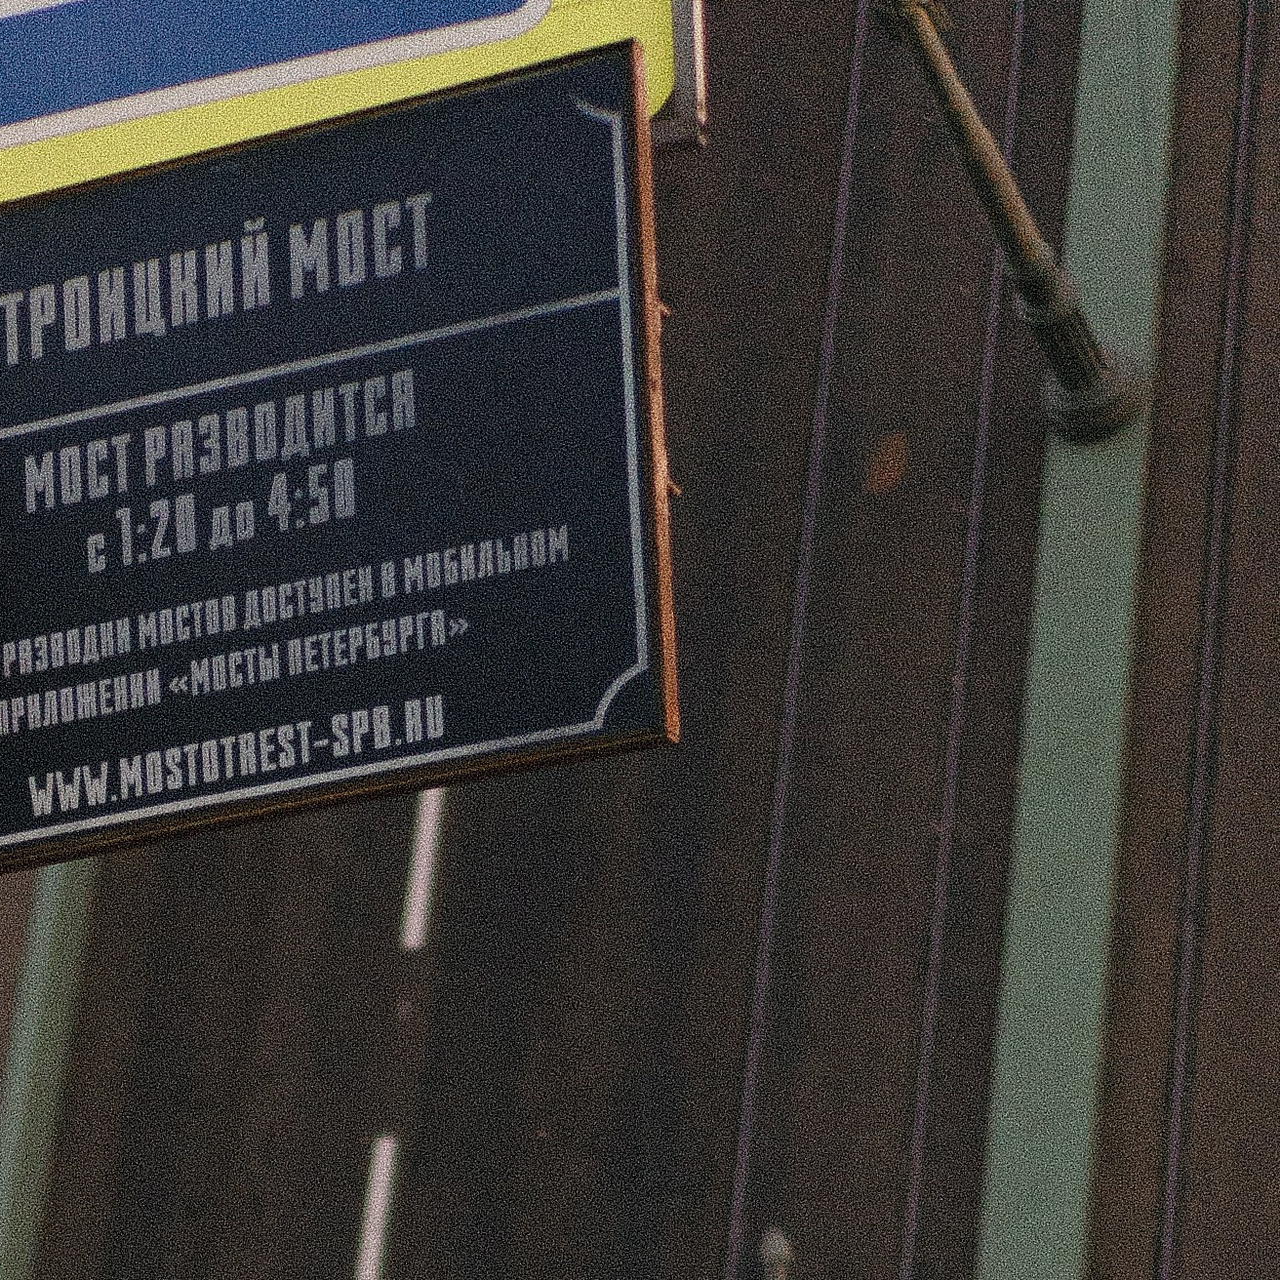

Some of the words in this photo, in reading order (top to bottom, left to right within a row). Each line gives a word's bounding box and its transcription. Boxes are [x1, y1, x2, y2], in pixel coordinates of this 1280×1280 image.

[288, 191, 434, 300] МОСТ
[24, 433, 132, 513] МОСТ
[144, 369, 417, 487] РАЗВОДИТСЯ
[86, 533, 106, 574] с
[116, 494, 197, 567] 1:20
[209, 500, 255, 552] до
[267, 458, 356, 532] 4:50
[2, 617, 131, 678] РАЗВОДКИ
[137, 595, 237, 651] МОСТОВ
[243, 565, 373, 631] ДОСТУПЕН
[381, 560, 397, 599] В
[403, 524, 570, 595] МОБИЛЬНОМ
[169, 641, 280, 697] «МОСТЫ
[287, 608, 469, 677] ПЕТЕРБУРГА»
[28, 694, 446, 818] WWW.MOSTOTREST-SPB.RU
